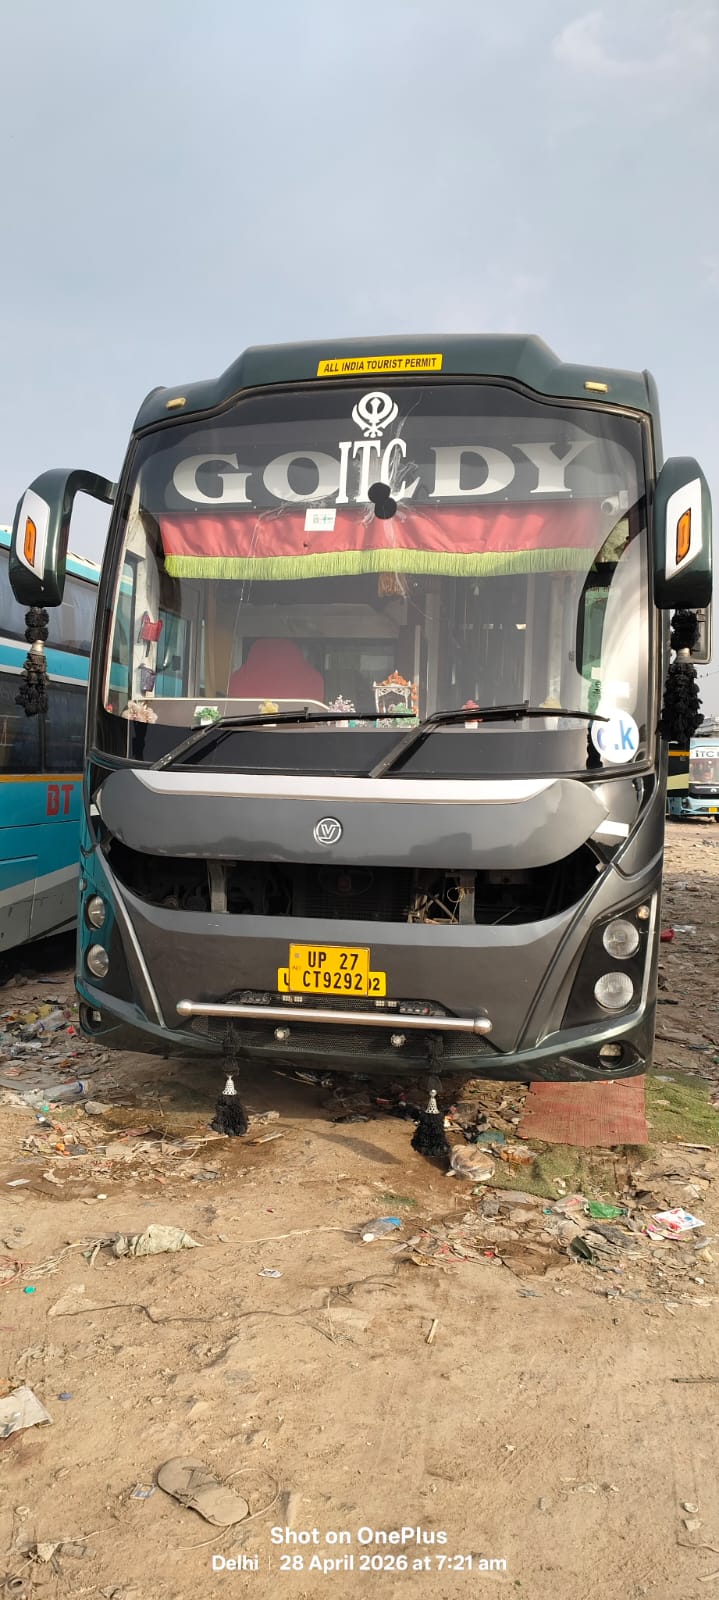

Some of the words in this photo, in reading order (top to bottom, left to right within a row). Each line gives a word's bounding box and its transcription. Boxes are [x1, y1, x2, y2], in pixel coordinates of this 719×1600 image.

[323, 363, 339, 373] ALL
[342, 361, 364, 372] INDIA
[367, 359, 402, 370] TOURIST
[405, 357, 437, 368] PERMIT
[335, 438, 407, 504] ITC
[47, 784, 74, 816] BT
[308, 951, 327, 968] UP
[340, 953, 359, 970] 27
[303, 970, 363, 991] CT9292
